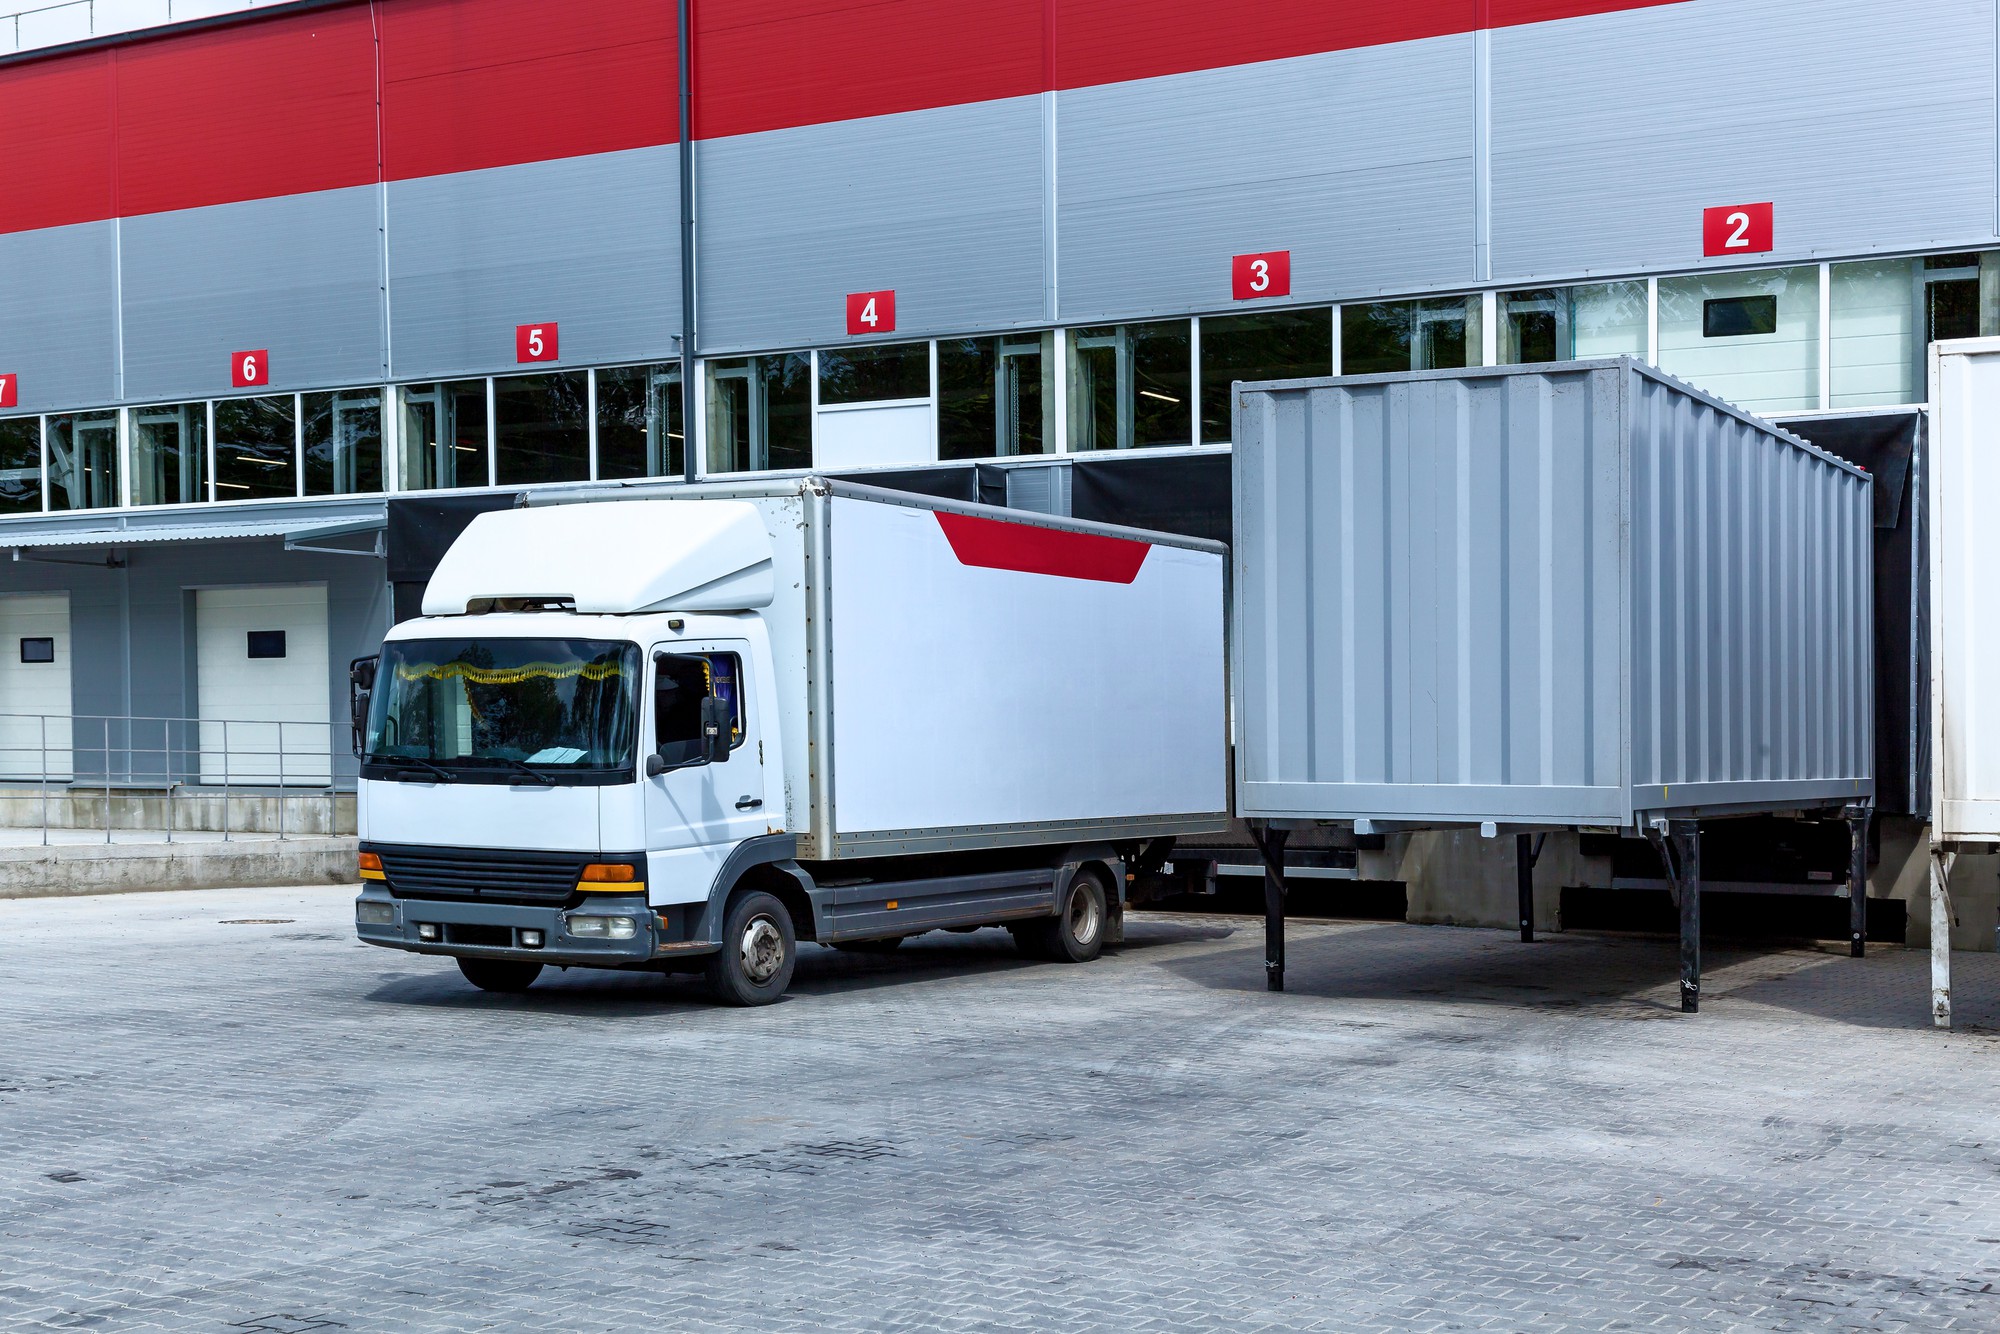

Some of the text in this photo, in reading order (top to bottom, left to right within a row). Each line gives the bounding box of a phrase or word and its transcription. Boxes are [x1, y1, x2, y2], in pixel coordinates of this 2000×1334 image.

[1725, 212, 1749, 247] 2
[1250, 260, 1269, 291] 3
[861, 298, 878, 326] 4
[528, 329, 543, 356] 5
[243, 356, 257, 381] 6
